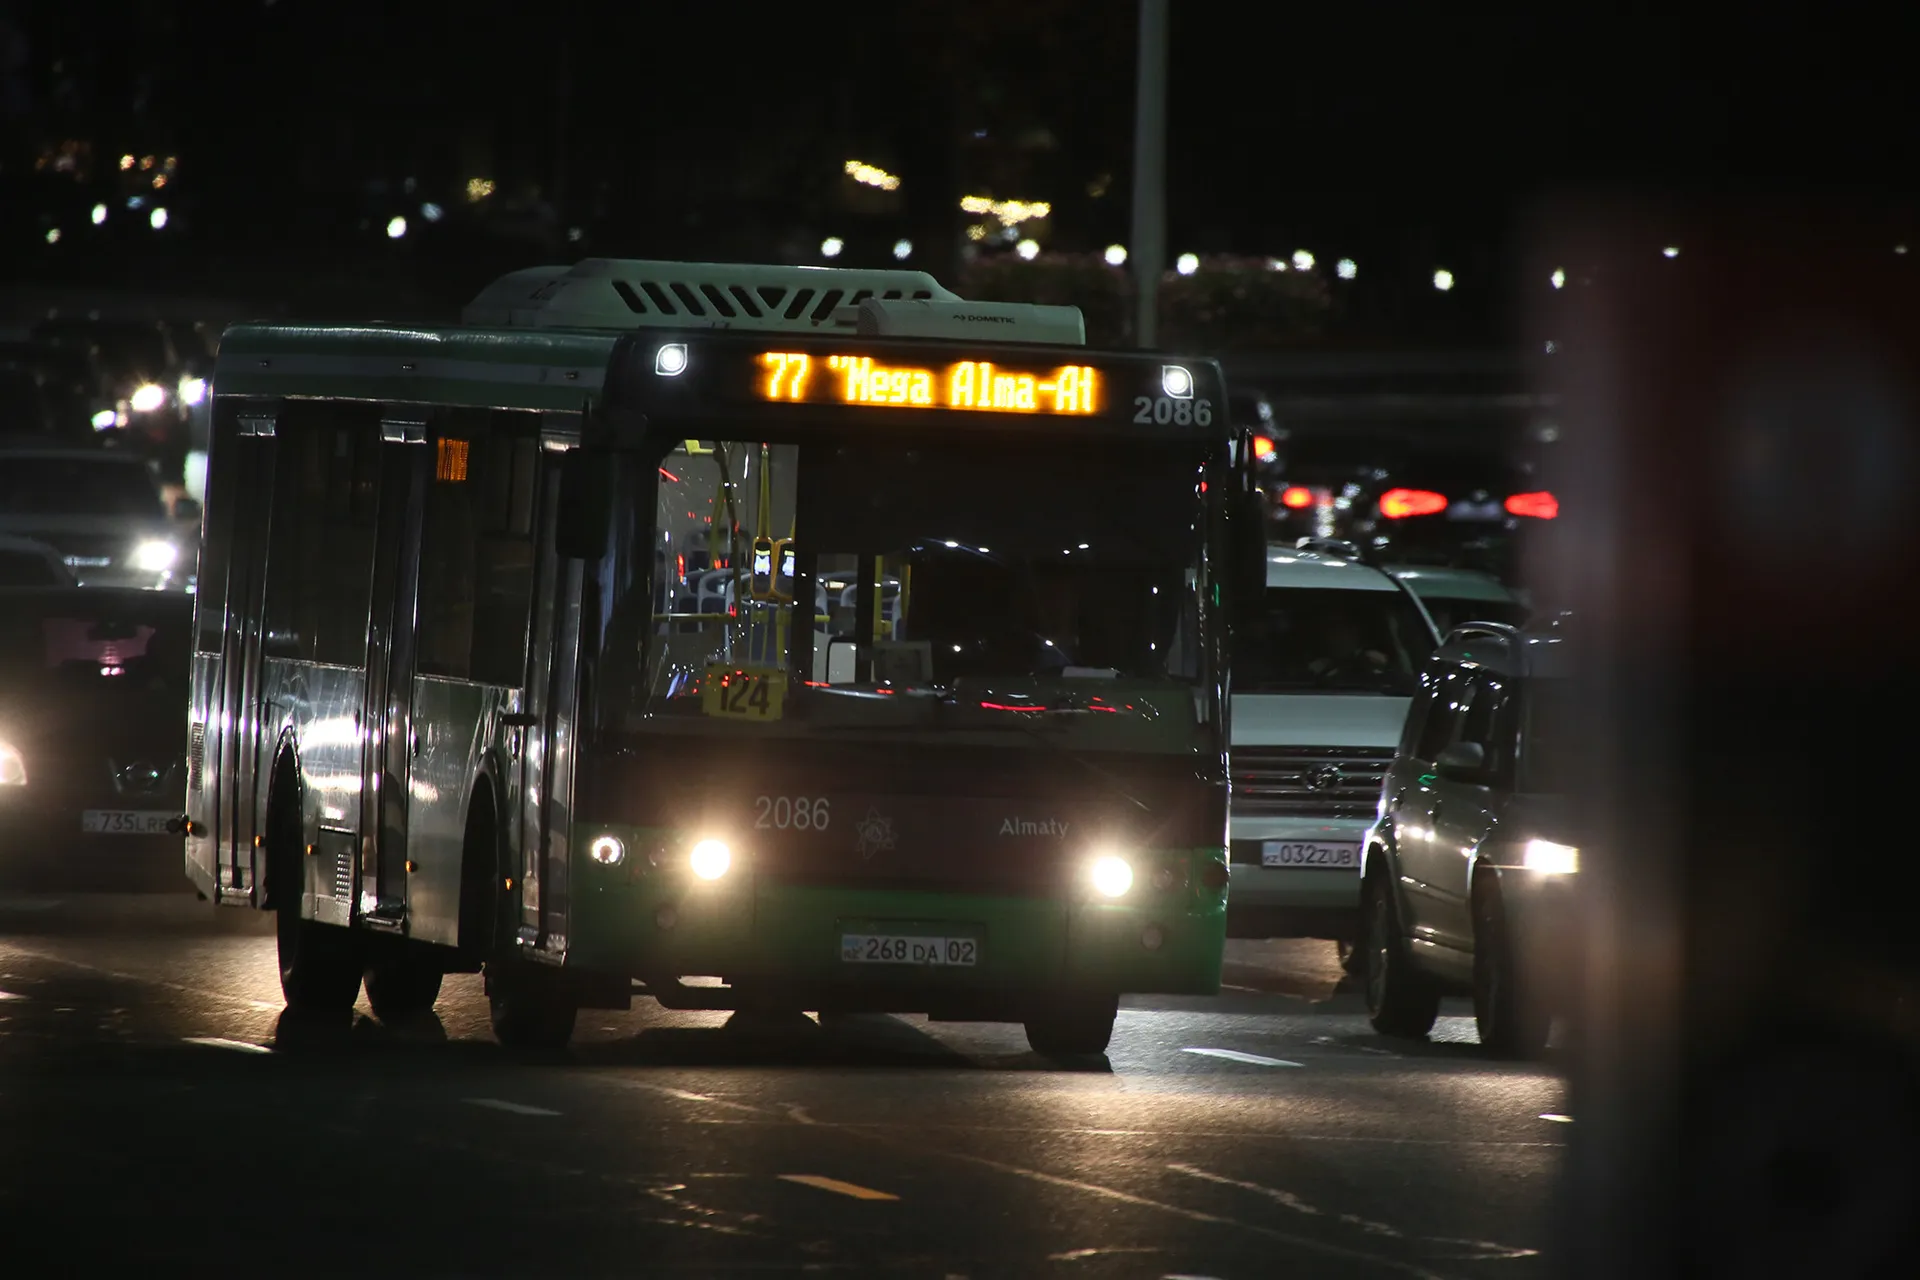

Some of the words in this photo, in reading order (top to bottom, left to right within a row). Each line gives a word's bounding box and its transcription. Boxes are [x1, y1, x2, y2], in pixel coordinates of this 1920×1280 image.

[968, 315, 1016, 325] DOMETIC
[766, 352, 808, 398] 77
[1133, 395, 1212, 427] 2086
[719, 673, 770, 715] 124
[754, 795, 831, 832] 2086
[999, 817, 1070, 840] Almaty
[866, 938, 907, 961] 268
[912, 944, 939, 962] DA
[947, 941, 975, 964] 02
